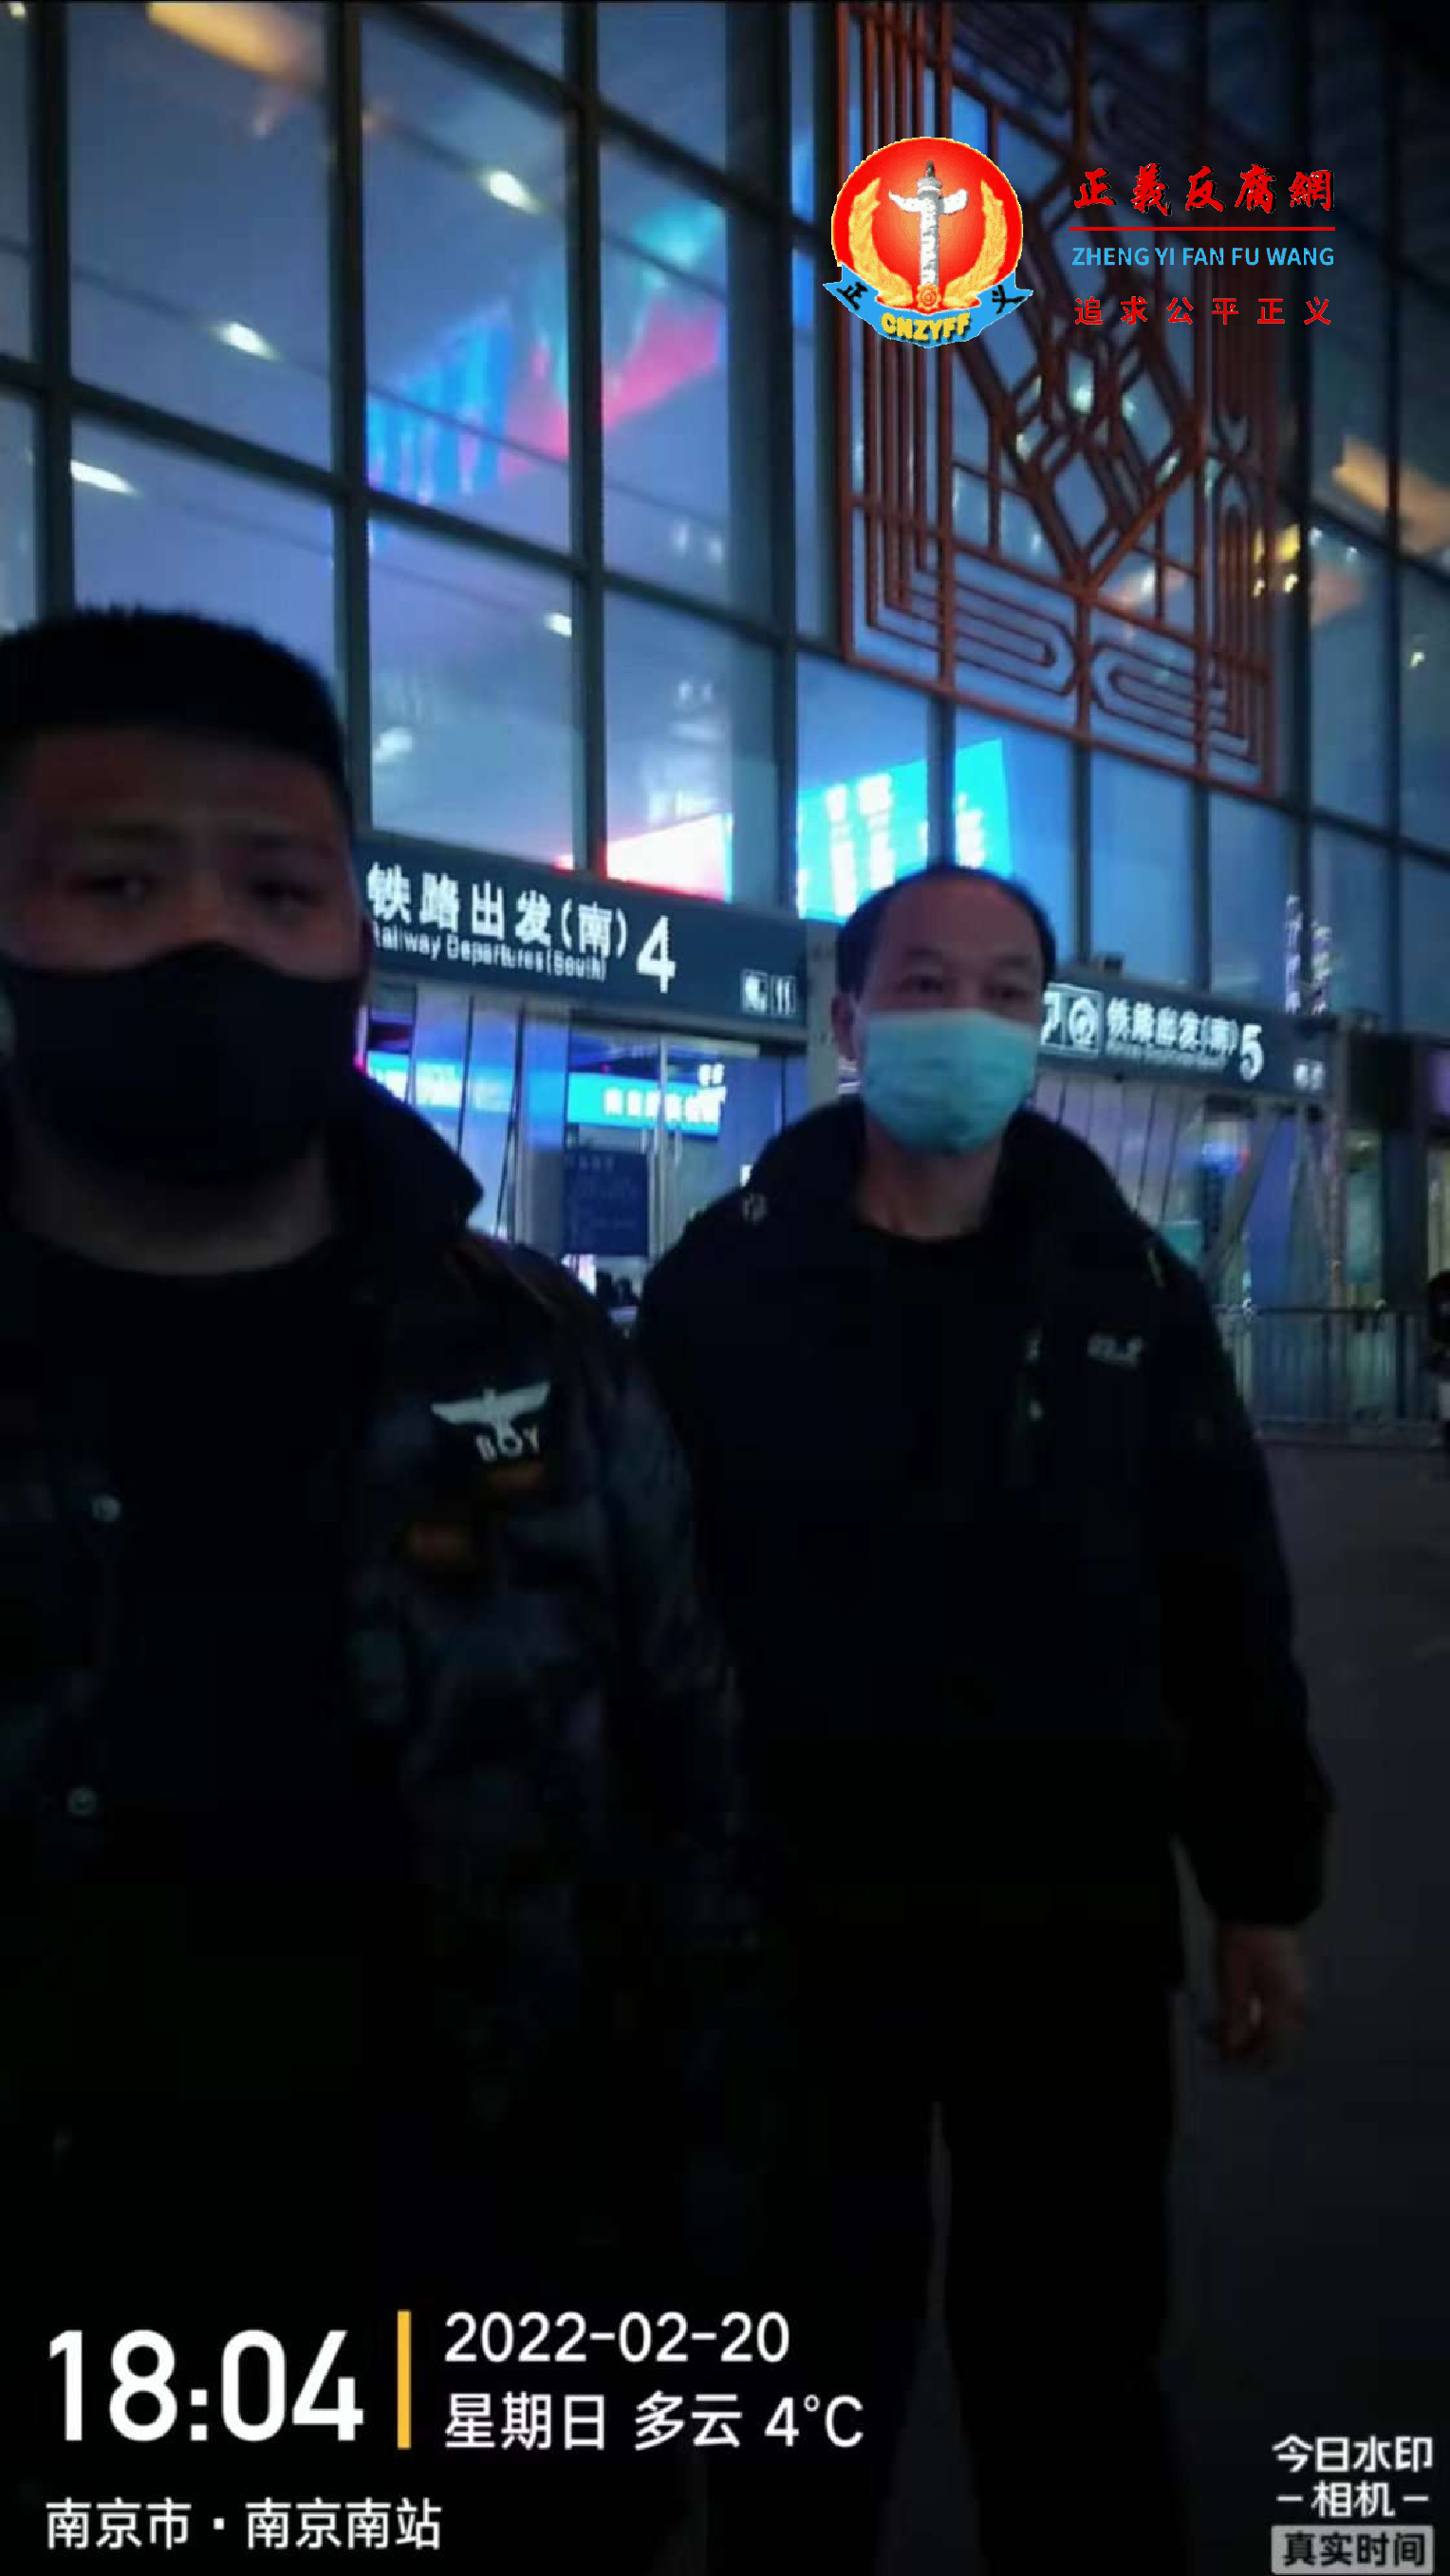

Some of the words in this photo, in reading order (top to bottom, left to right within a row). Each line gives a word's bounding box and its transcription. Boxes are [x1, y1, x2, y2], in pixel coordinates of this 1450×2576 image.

[636, 915, 677, 995] 4
[1239, 1022, 1265, 1083] 5
[475, 1425, 541, 1462] BOY
